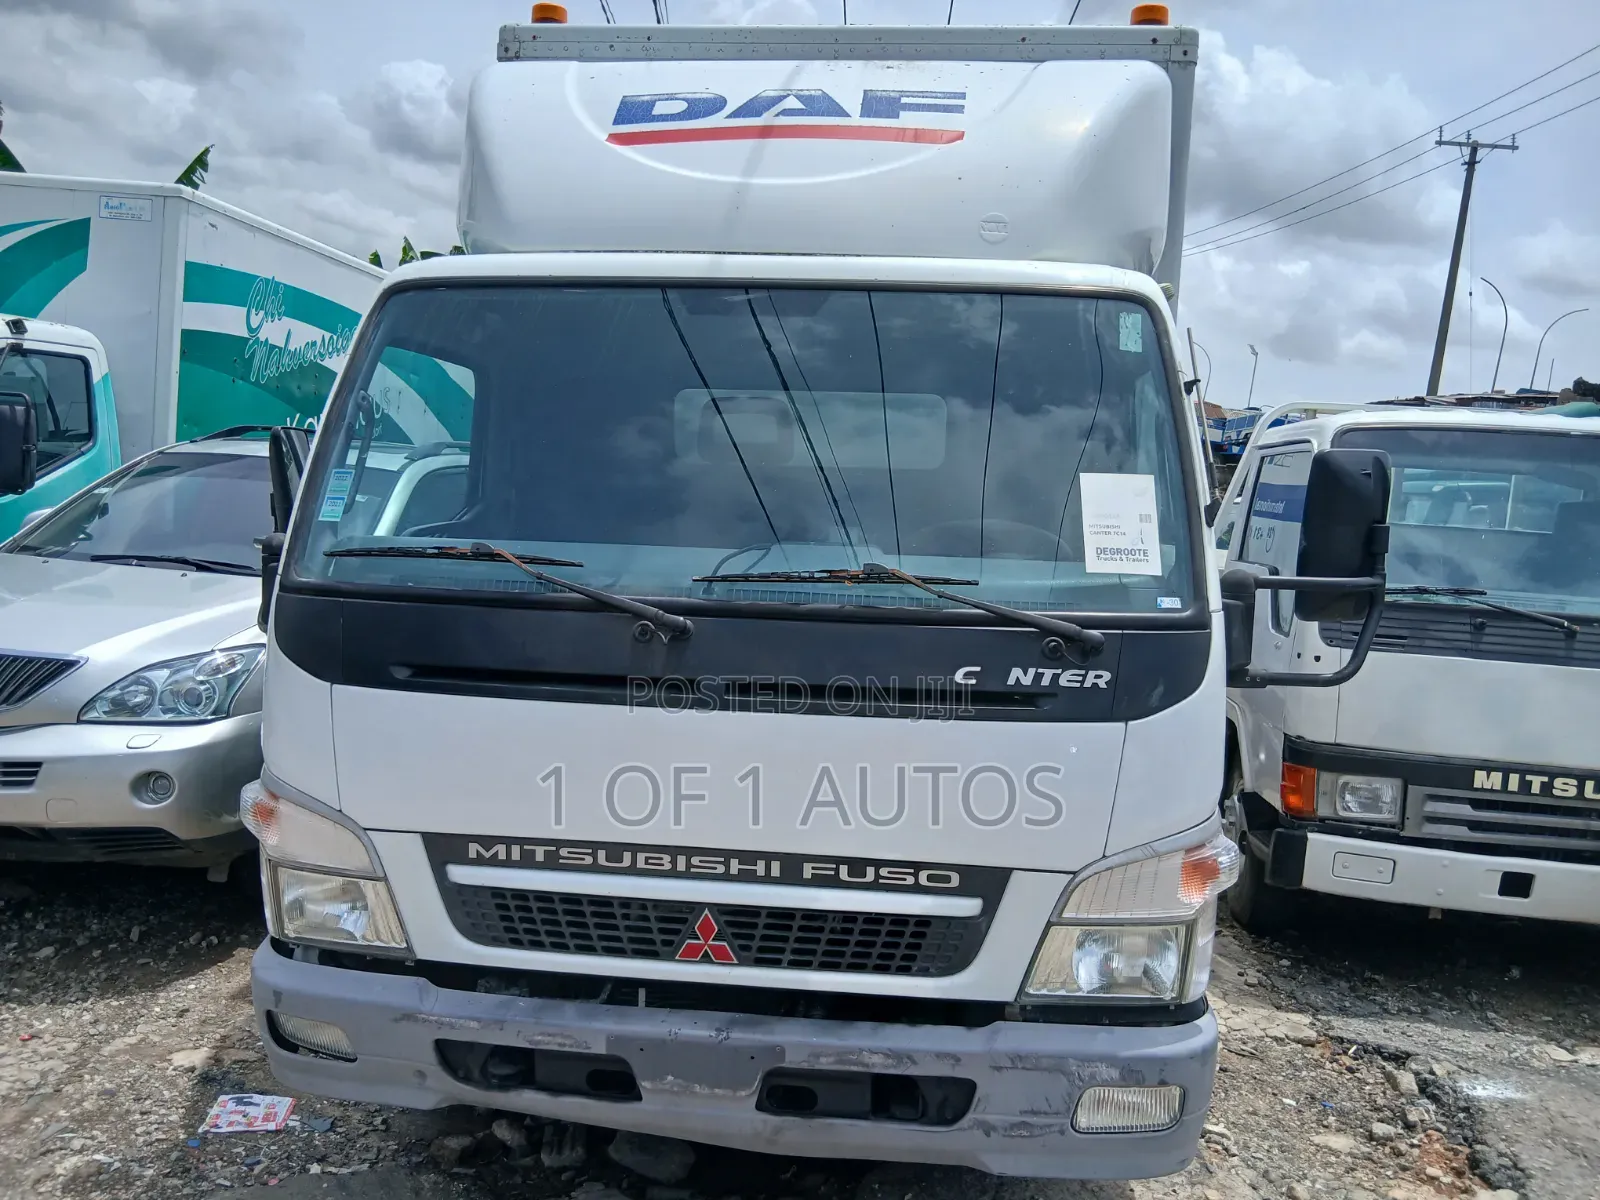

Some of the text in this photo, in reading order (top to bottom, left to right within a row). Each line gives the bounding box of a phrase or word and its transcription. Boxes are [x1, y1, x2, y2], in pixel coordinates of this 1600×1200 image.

[612, 88, 966, 126] DAF
[1095, 546, 1149, 558] DEGROOTE
[1473, 769, 1600, 800] MITSU
[467, 842, 960, 889] MITSUBISHI FUSO
